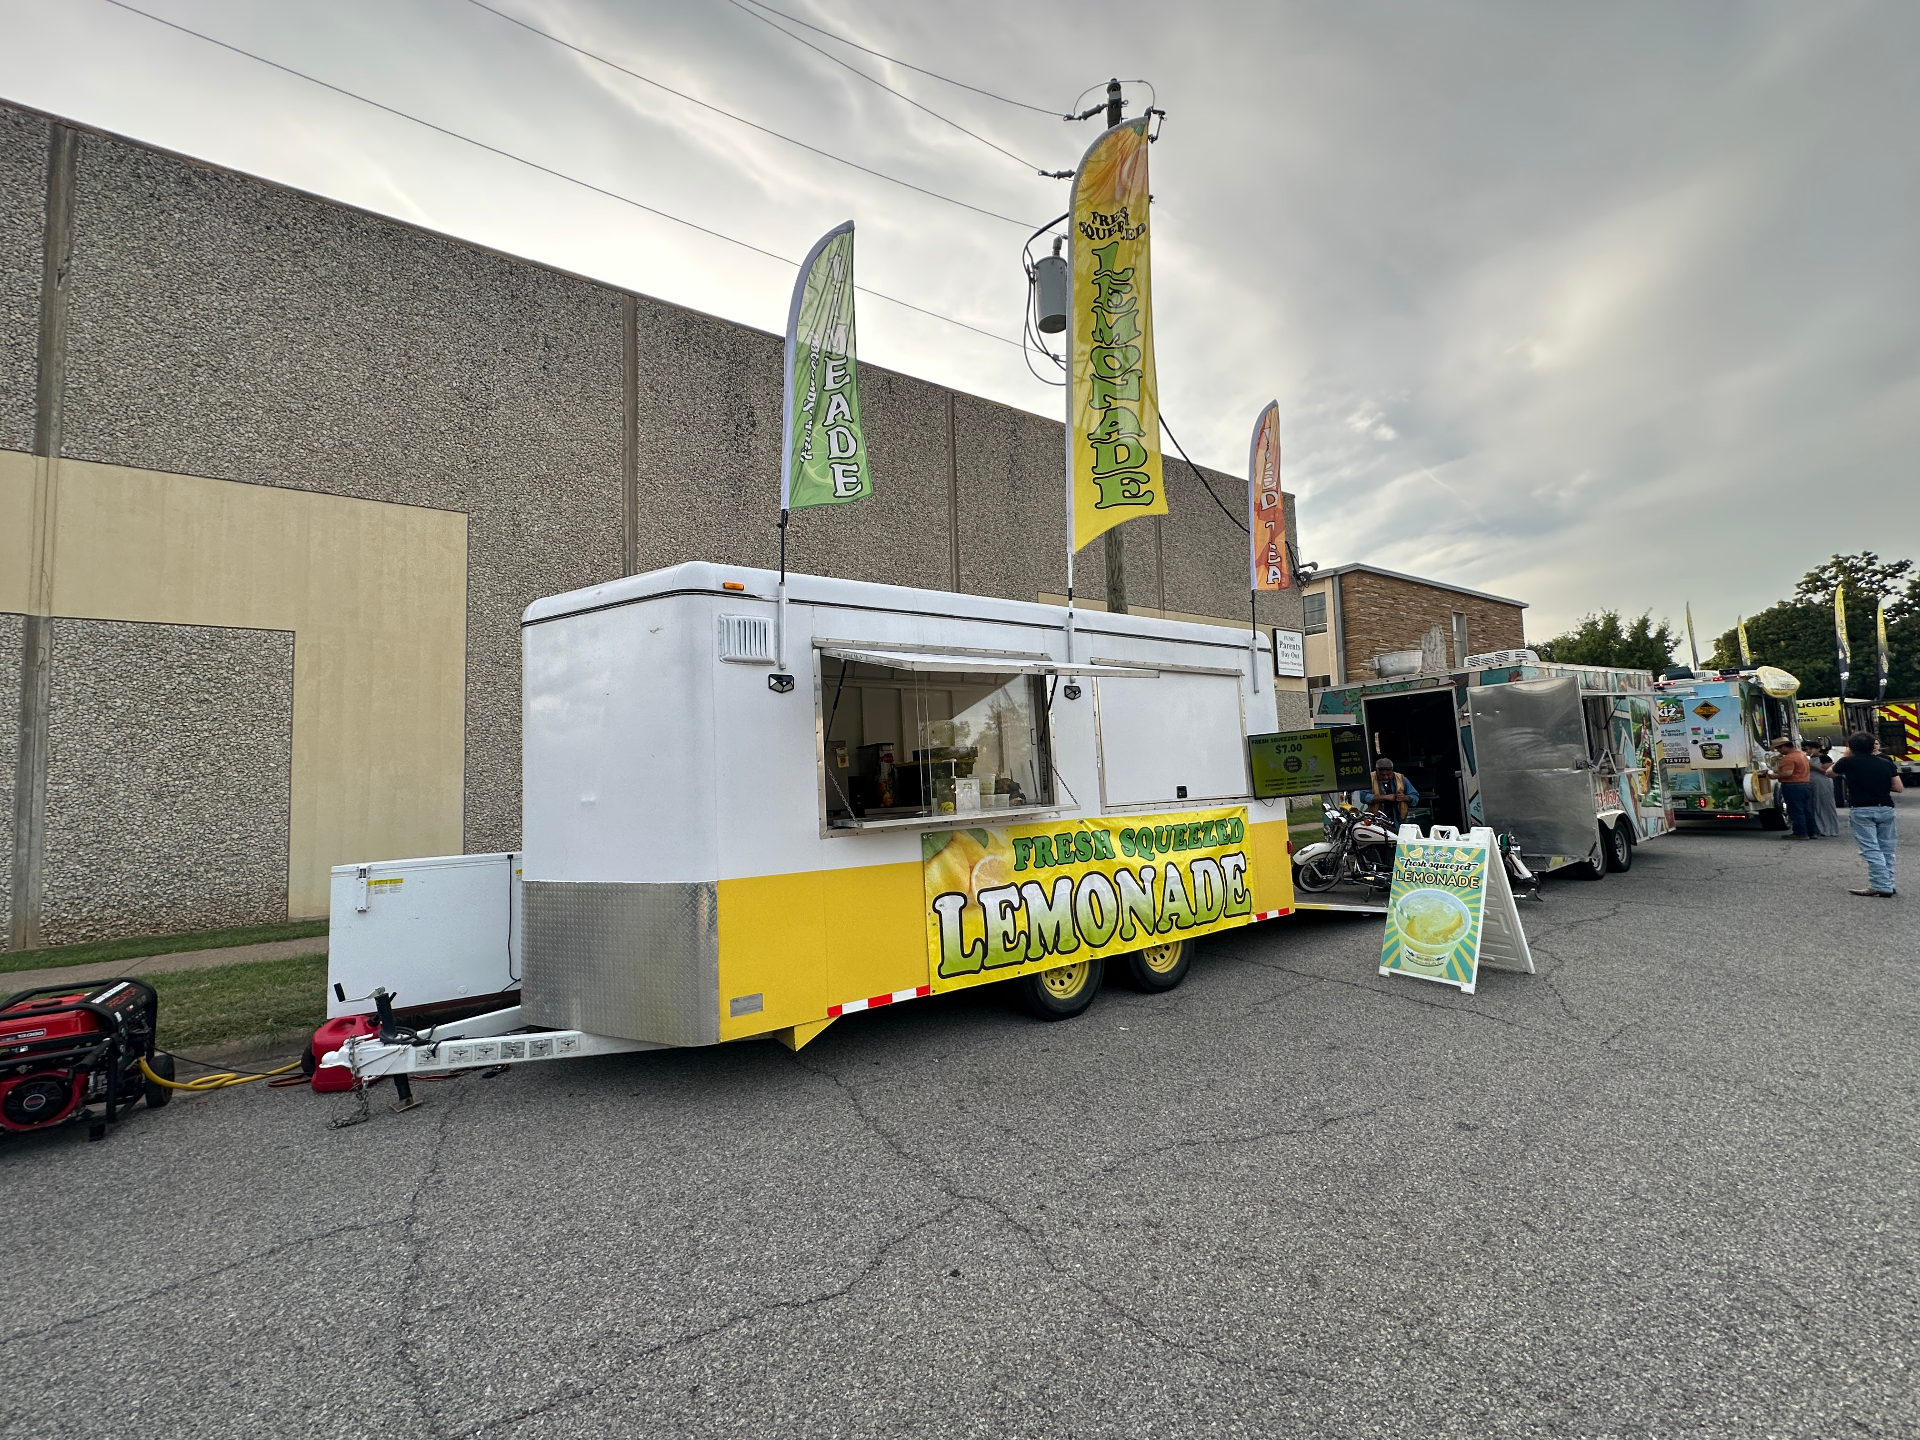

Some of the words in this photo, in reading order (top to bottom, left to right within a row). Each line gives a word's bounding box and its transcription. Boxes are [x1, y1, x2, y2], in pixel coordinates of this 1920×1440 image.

[1078, 220, 1147, 241] SQUEEED
[1087, 241, 1155, 510] LEMONADE
[1279, 640, 1301, 650] Parents
[1270, 735, 1298, 743] SQUEEZED
[1299, 732, 1329, 740] LEMONADE
[1275, 743, 1303, 754] $7.00
[1339, 765, 1364, 776] $5.00
[1012, 828, 1115, 871] FRESH
[1118, 817, 1245, 862] SQUEEZED
[1400, 857, 1428, 868] fresh
[1428, 861, 1479, 873] squeezed
[1395, 870, 1480, 889] LEMONADE
[932, 851, 1252, 979] LEMONADE
